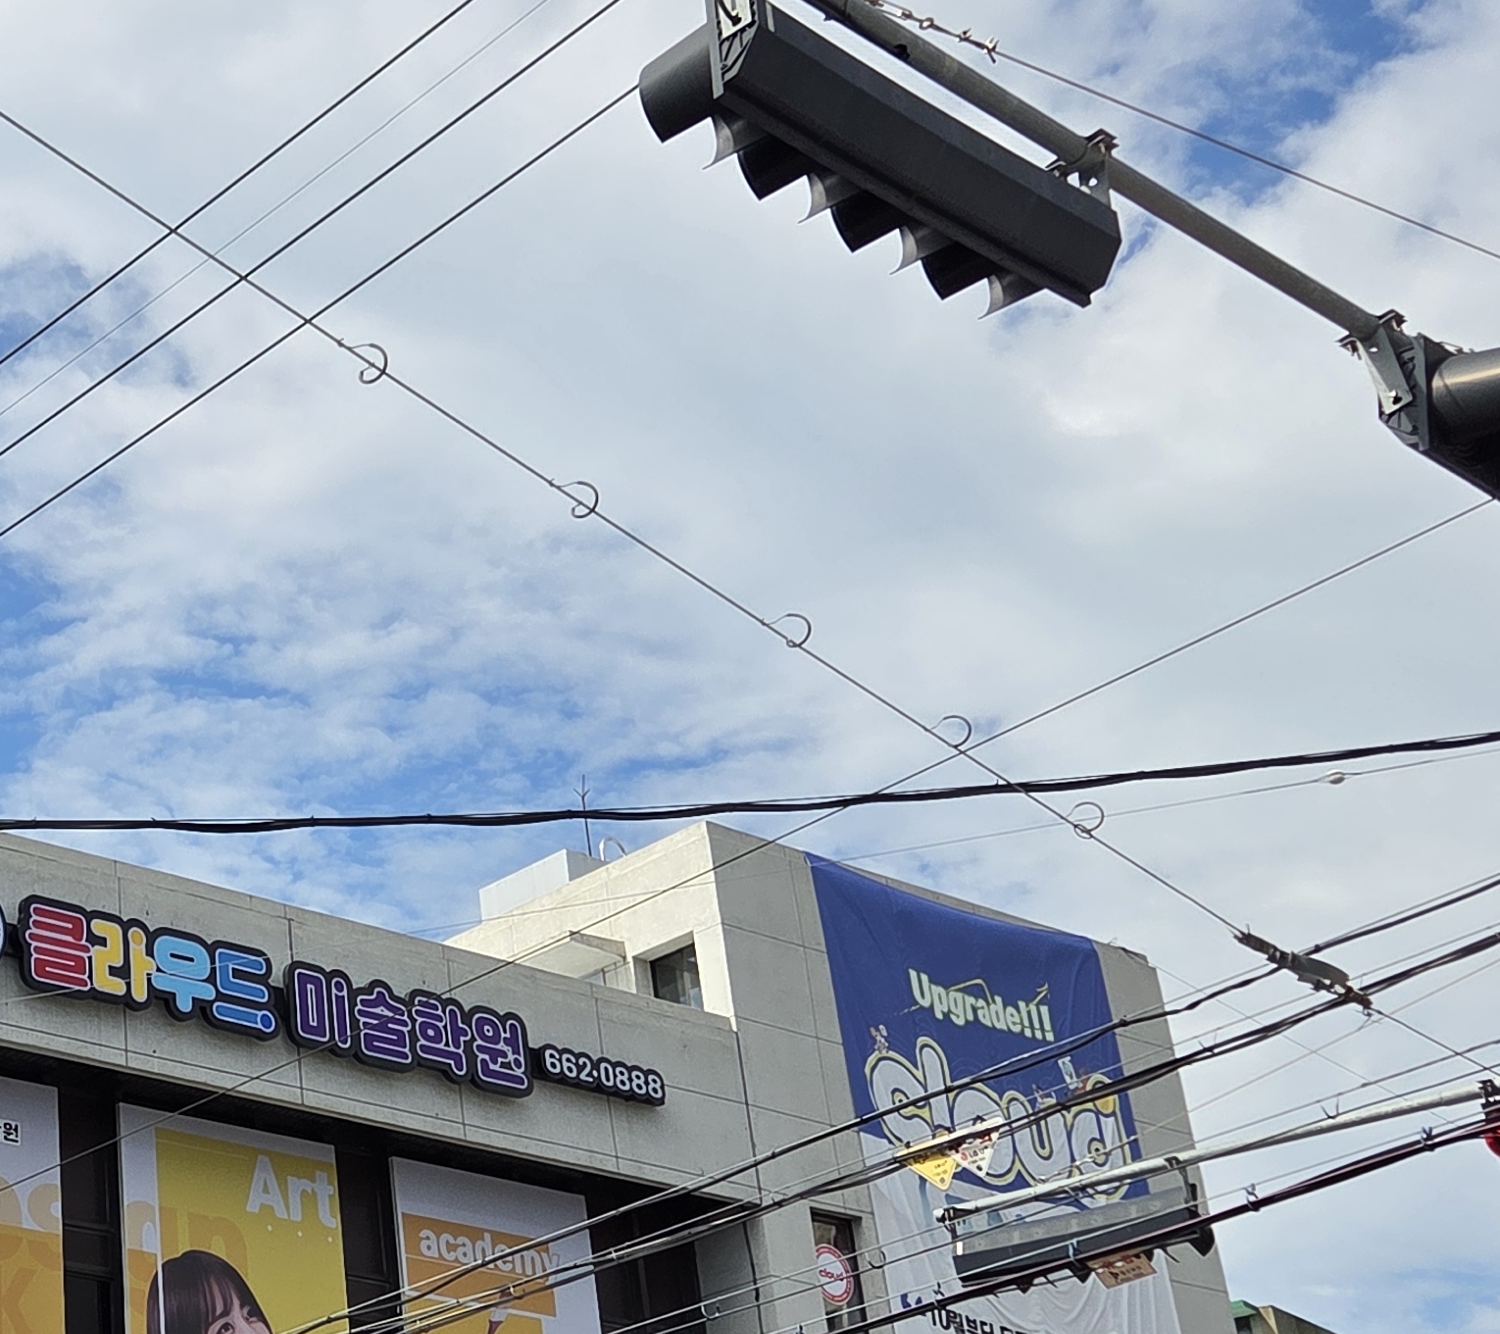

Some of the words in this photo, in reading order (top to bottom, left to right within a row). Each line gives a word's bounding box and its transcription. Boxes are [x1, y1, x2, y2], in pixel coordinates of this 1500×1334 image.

[26, 903, 277, 1034] 클라우드
[294, 967, 529, 1089] 미술학원
[246, 1155, 337, 1228] Art
[418, 1228, 561, 1283] academy
